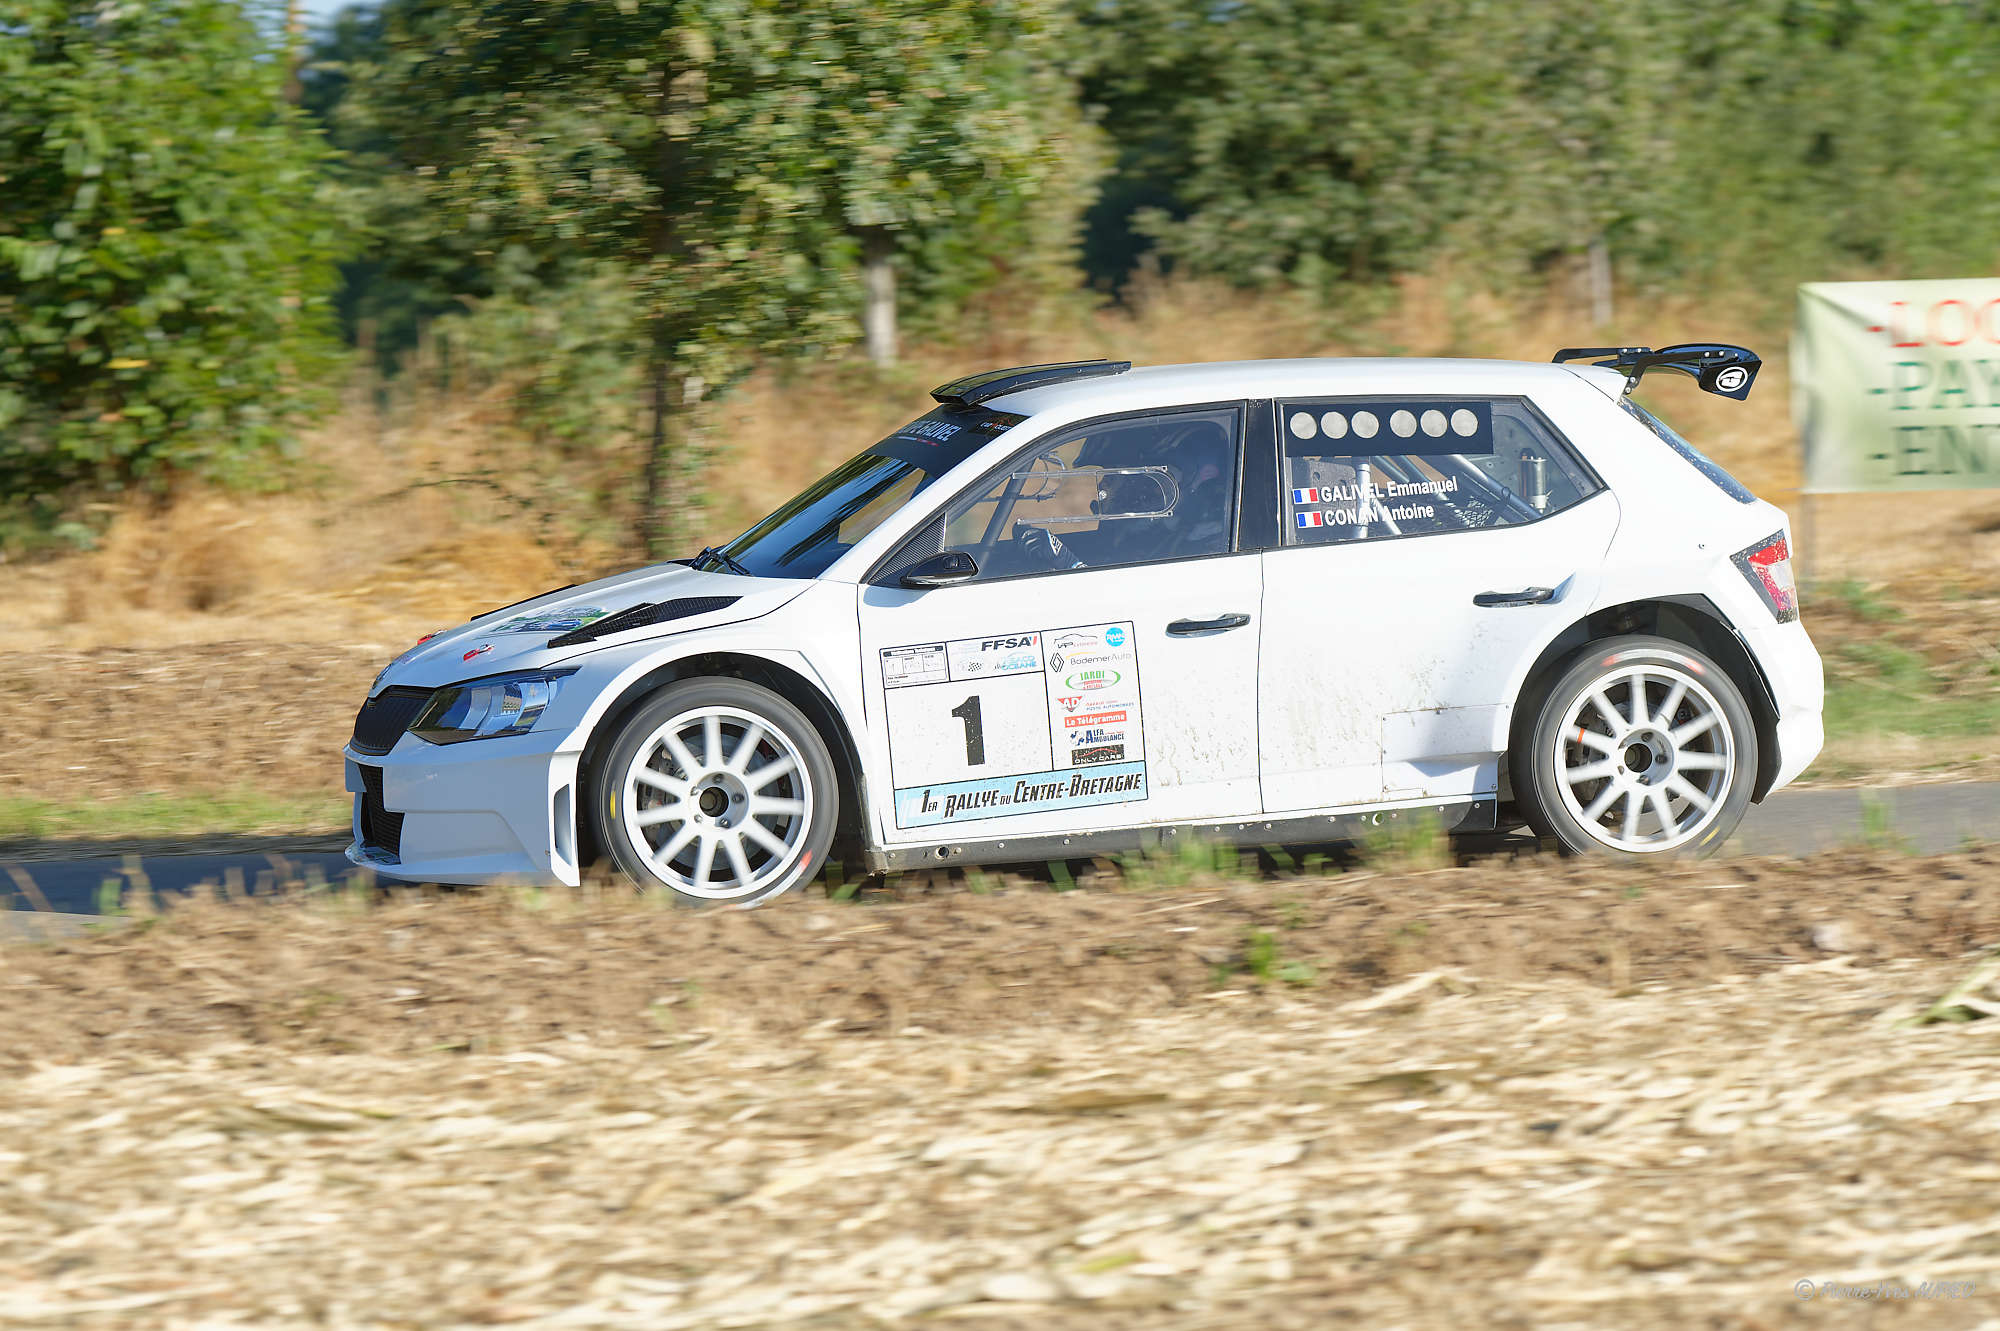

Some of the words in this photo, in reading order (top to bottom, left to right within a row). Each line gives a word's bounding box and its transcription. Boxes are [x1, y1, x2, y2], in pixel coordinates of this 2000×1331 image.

[1320, 481, 1385, 503] GALIVEL
[1387, 475, 1458, 497] Emmanuel
[1324, 508, 1379, 527] CONAN
[1381, 503, 1435, 521] Antoine
[981, 637, 1033, 652] FFSA
[1062, 697, 1080, 708] AD
[1066, 718, 1076, 726] Le
[1077, 713, 1126, 725] Télégramme
[951, 695, 986, 767] 1
[1074, 756, 1098, 764] ONLY
[1099, 753, 1123, 761] CARS
[944, 789, 1000, 818] RALLYE
[1000, 795, 1012, 805] DU
[1013, 773, 1143, 804] CENTRE-BRETAGNE
